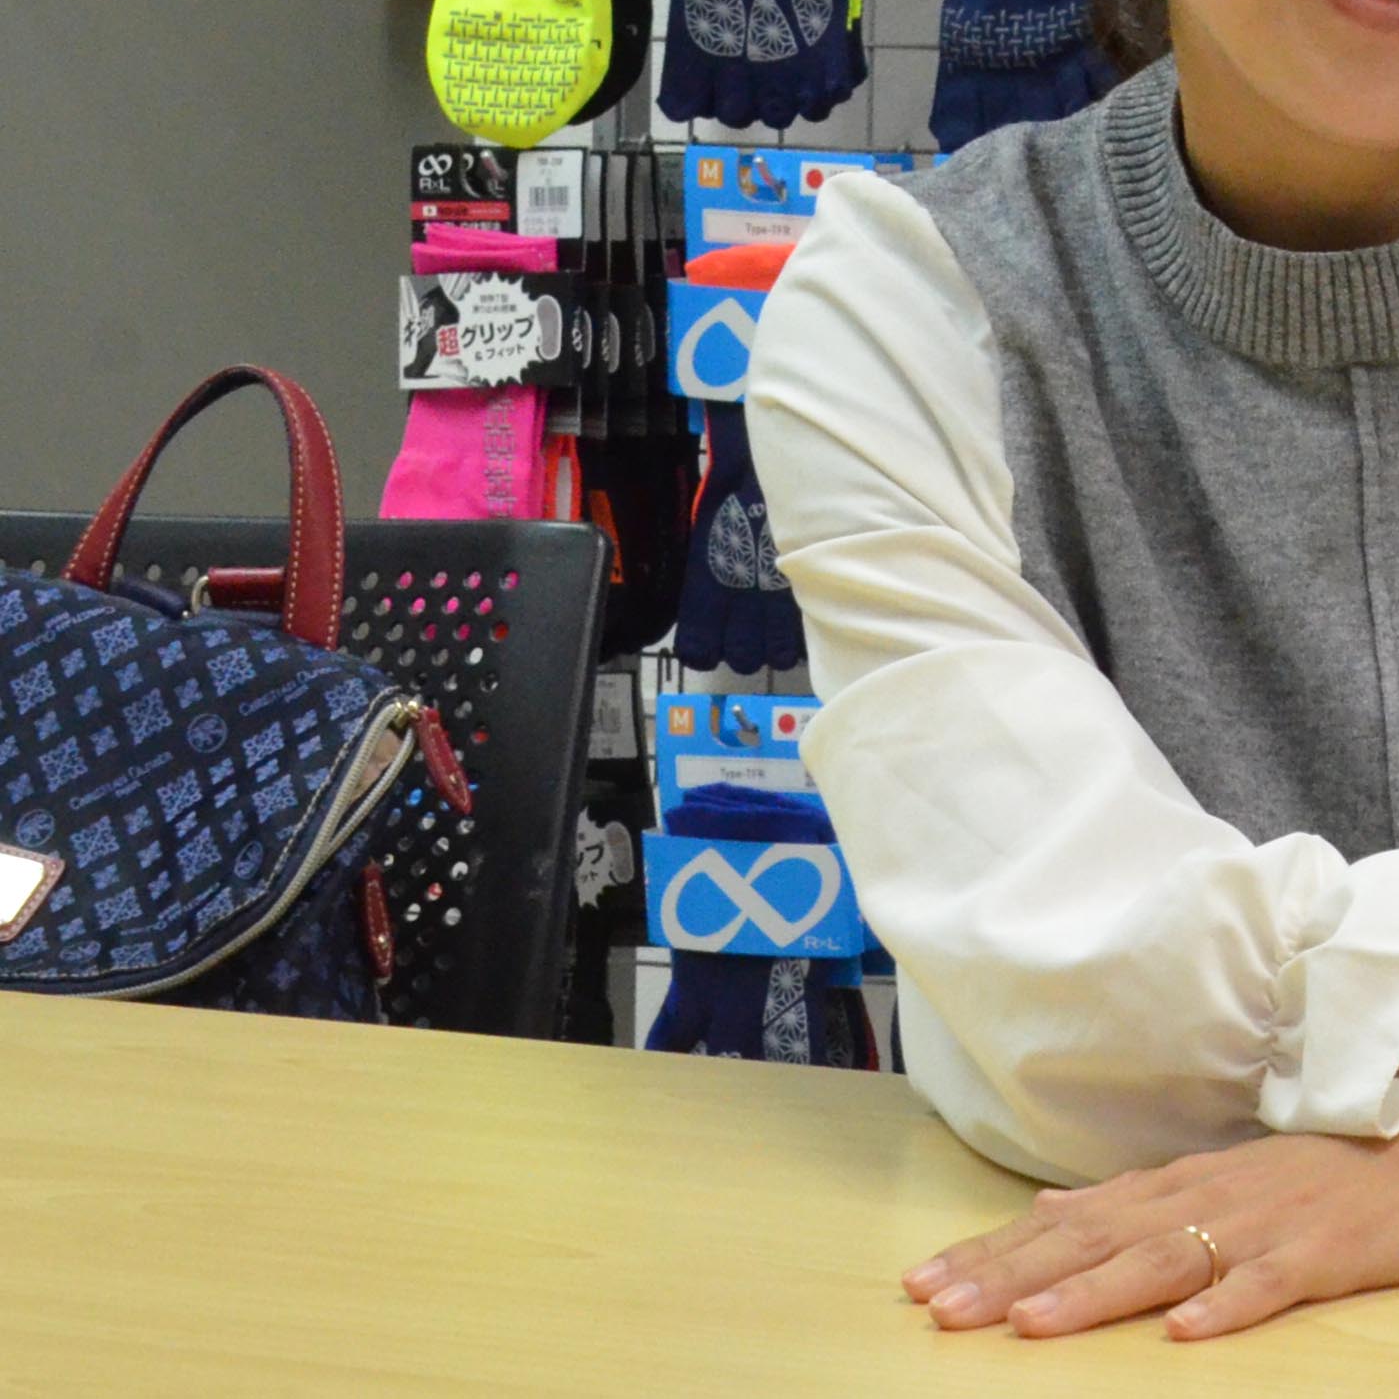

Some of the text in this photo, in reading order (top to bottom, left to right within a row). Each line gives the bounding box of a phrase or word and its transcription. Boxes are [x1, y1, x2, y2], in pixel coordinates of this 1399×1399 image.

[701, 162, 720, 182] M
[486, 344, 526, 360] フィット
[672, 708, 692, 730] M
